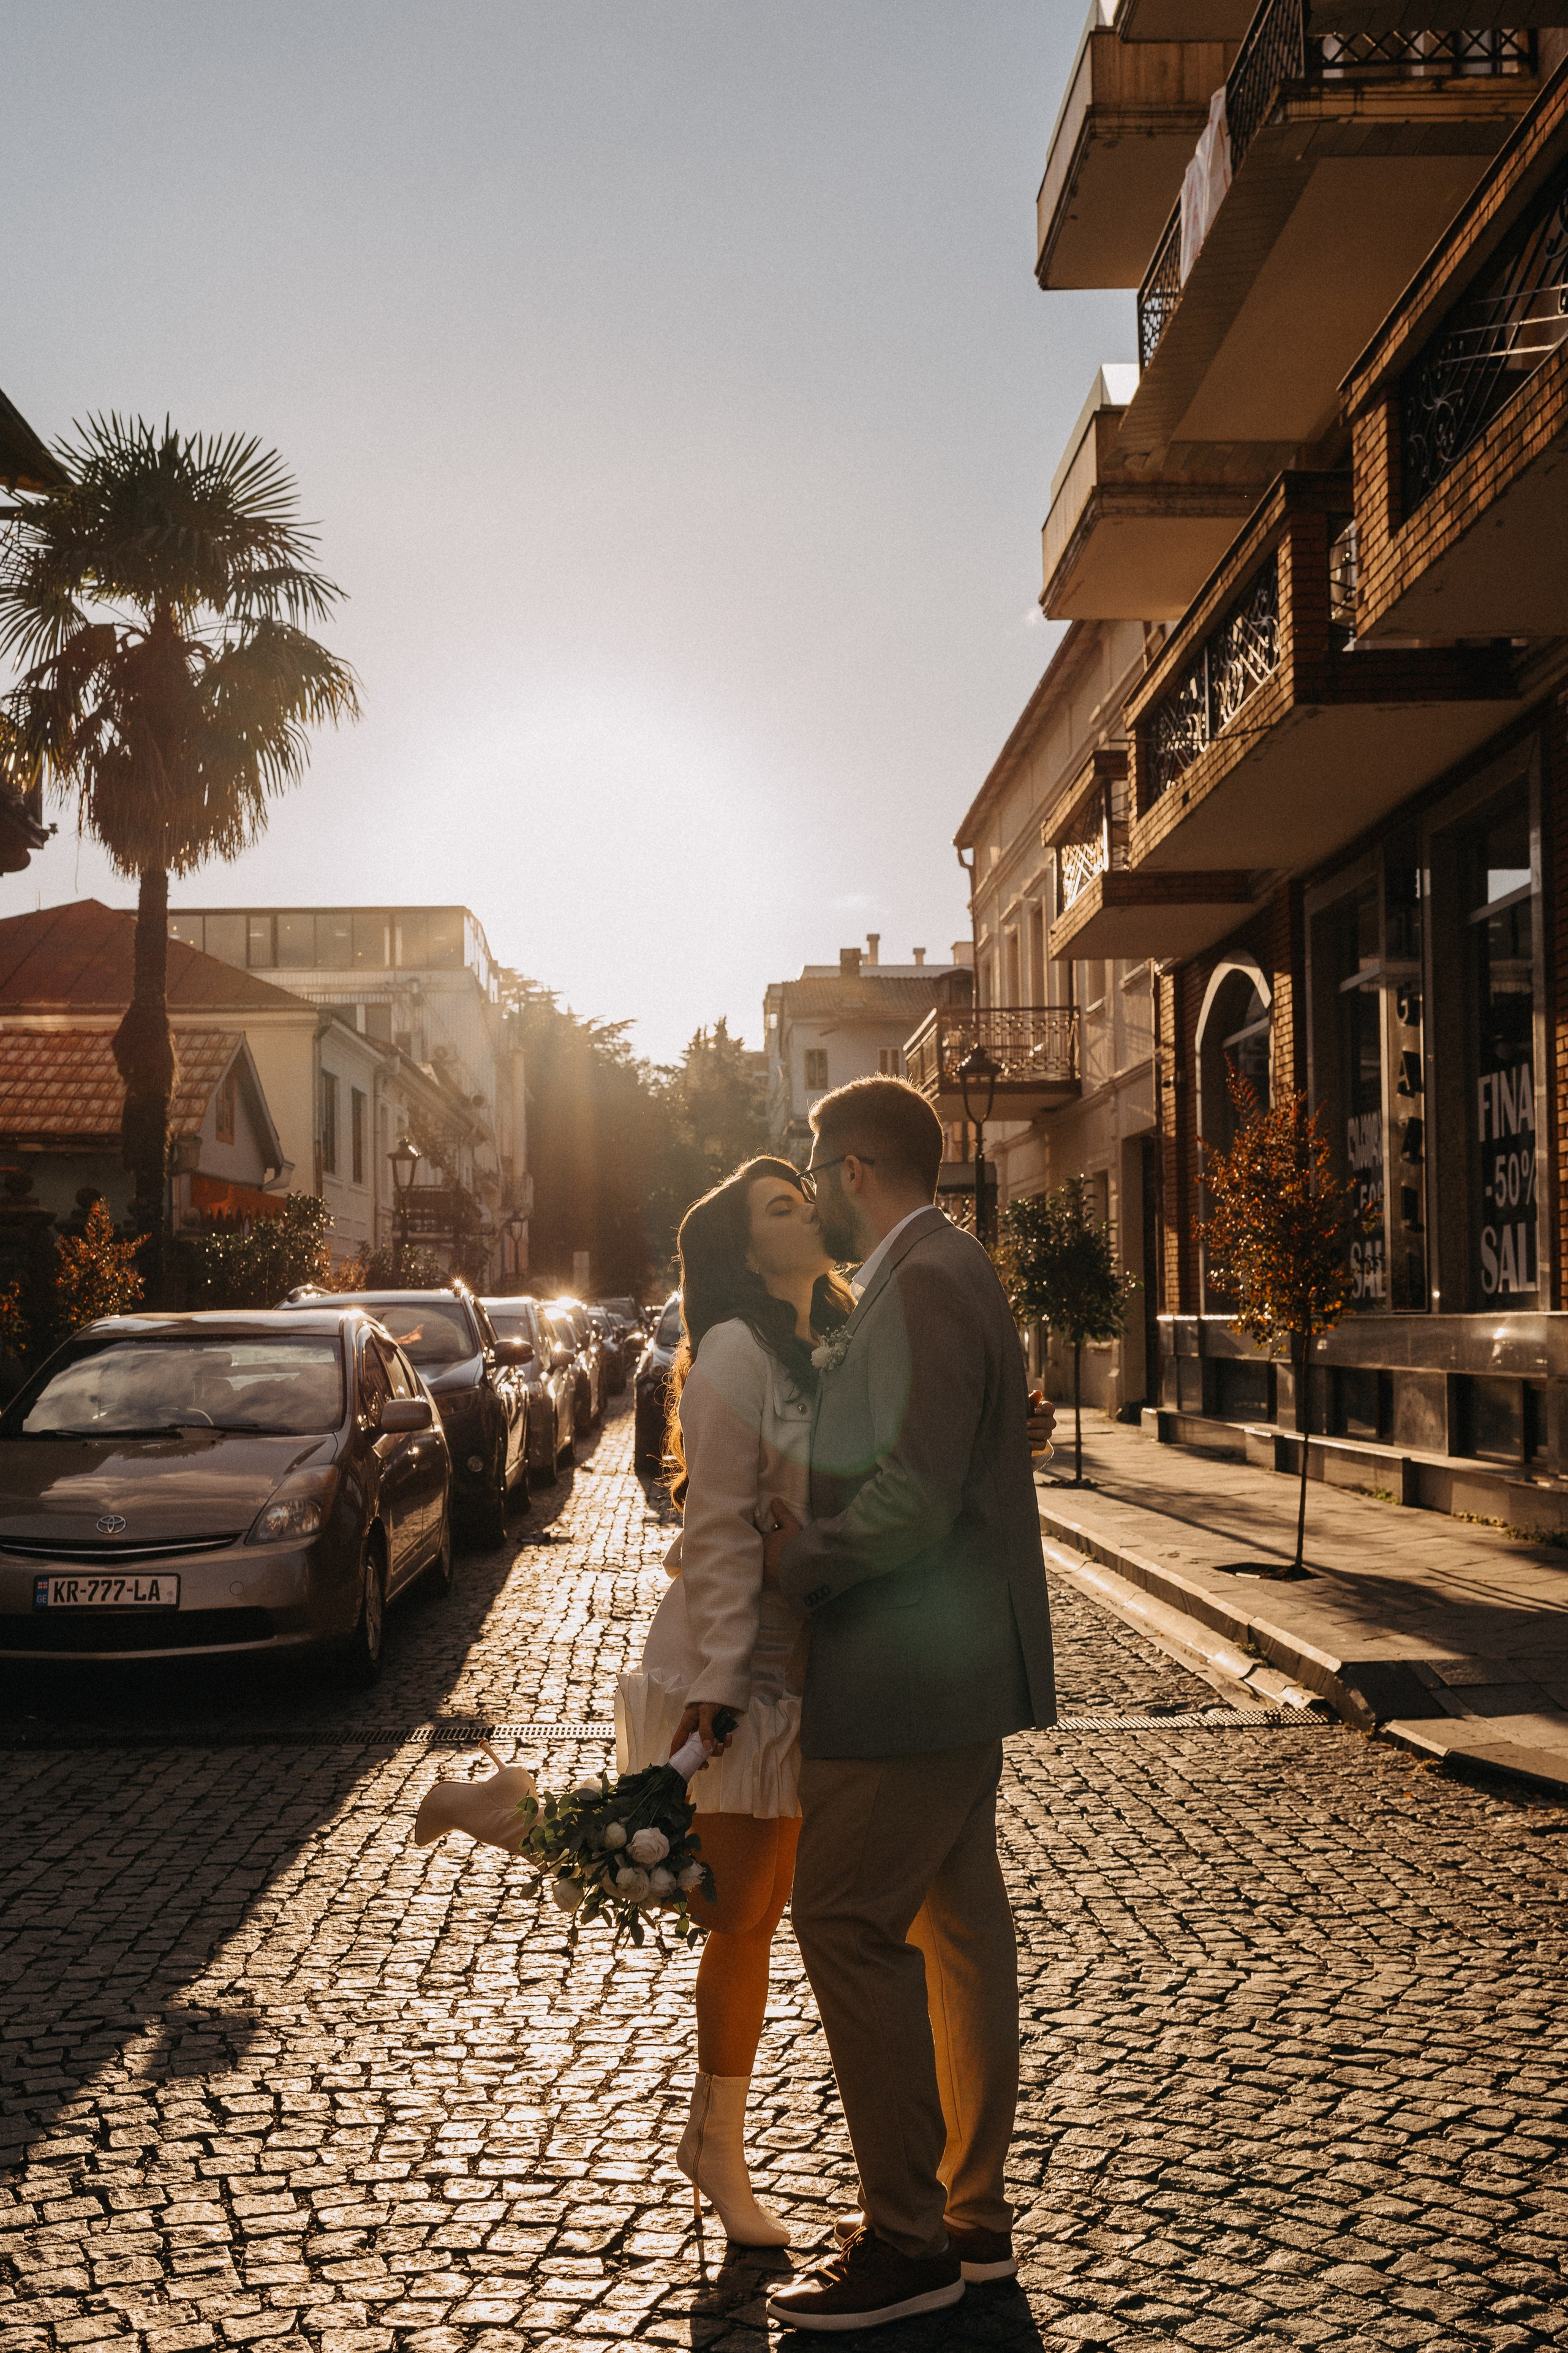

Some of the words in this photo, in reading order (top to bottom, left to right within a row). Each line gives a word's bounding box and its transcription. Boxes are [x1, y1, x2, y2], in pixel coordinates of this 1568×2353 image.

[1480, 1222, 1539, 1294] SAL
[37, 1595, 47, 1604] GE
[54, 1579, 160, 1603] KR-777-LA
